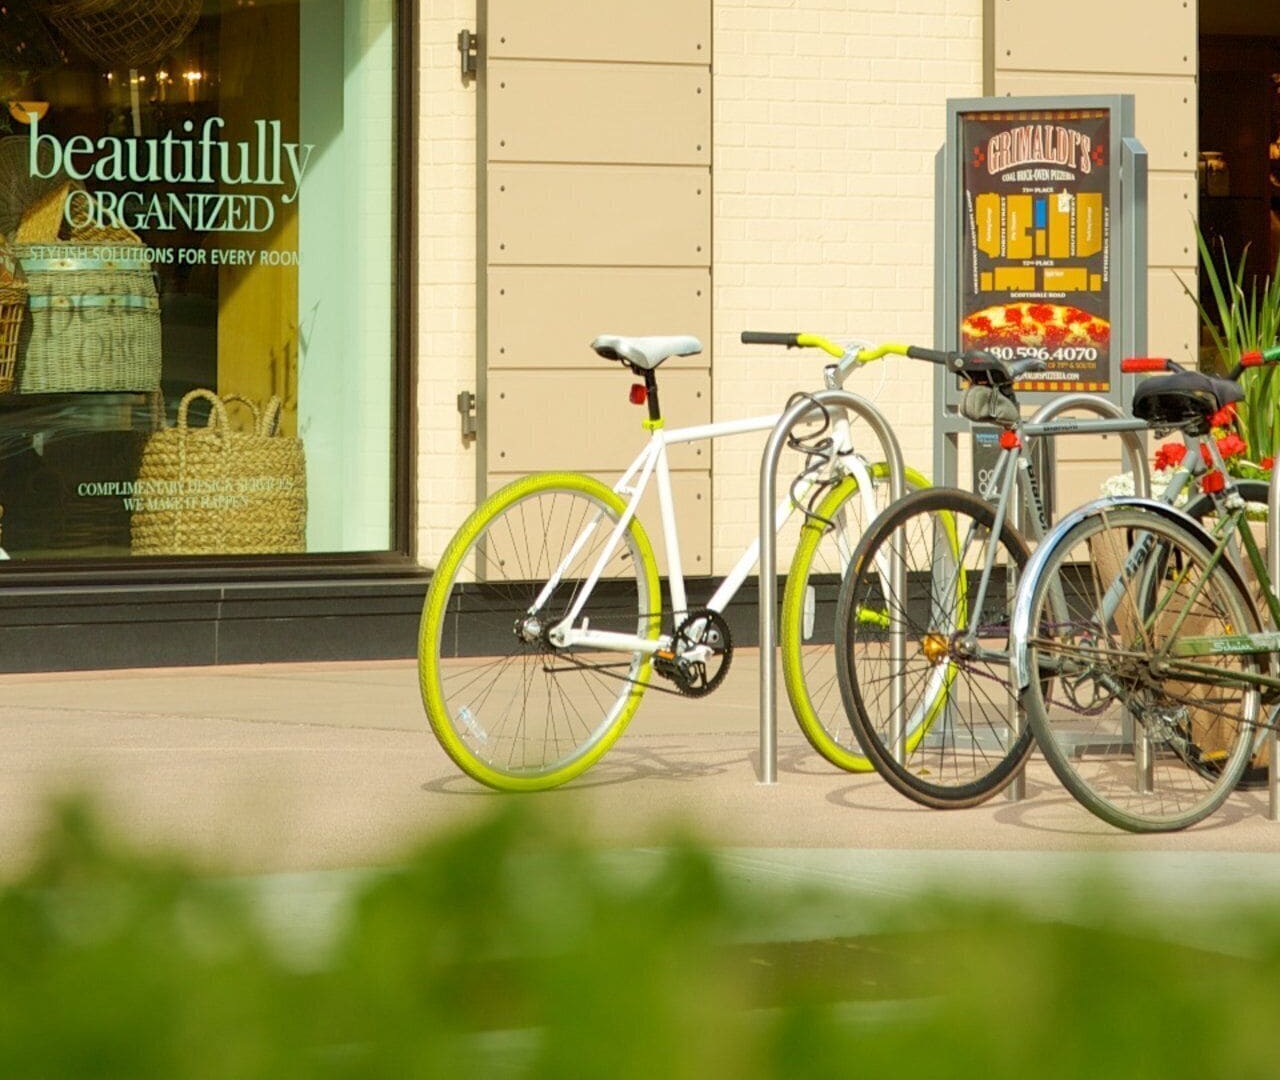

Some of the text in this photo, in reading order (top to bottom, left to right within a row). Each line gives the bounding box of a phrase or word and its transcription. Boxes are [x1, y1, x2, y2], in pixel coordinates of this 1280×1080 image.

[28, 112, 316, 204] beautifully
[987, 125, 1092, 175] GRIMALDI'S
[64, 190, 275, 233] ORGANIZED
[30, 246, 87, 261] STYLISH
[93, 247, 174, 264] SOLUTIONS
[178, 248, 207, 264] FOR
[211, 249, 256, 265] EVERY
[983, 347, 1098, 361] 80.596.4070
[78, 480, 184, 497] COMPLIMENTARY
[123, 498, 144, 512] WE
